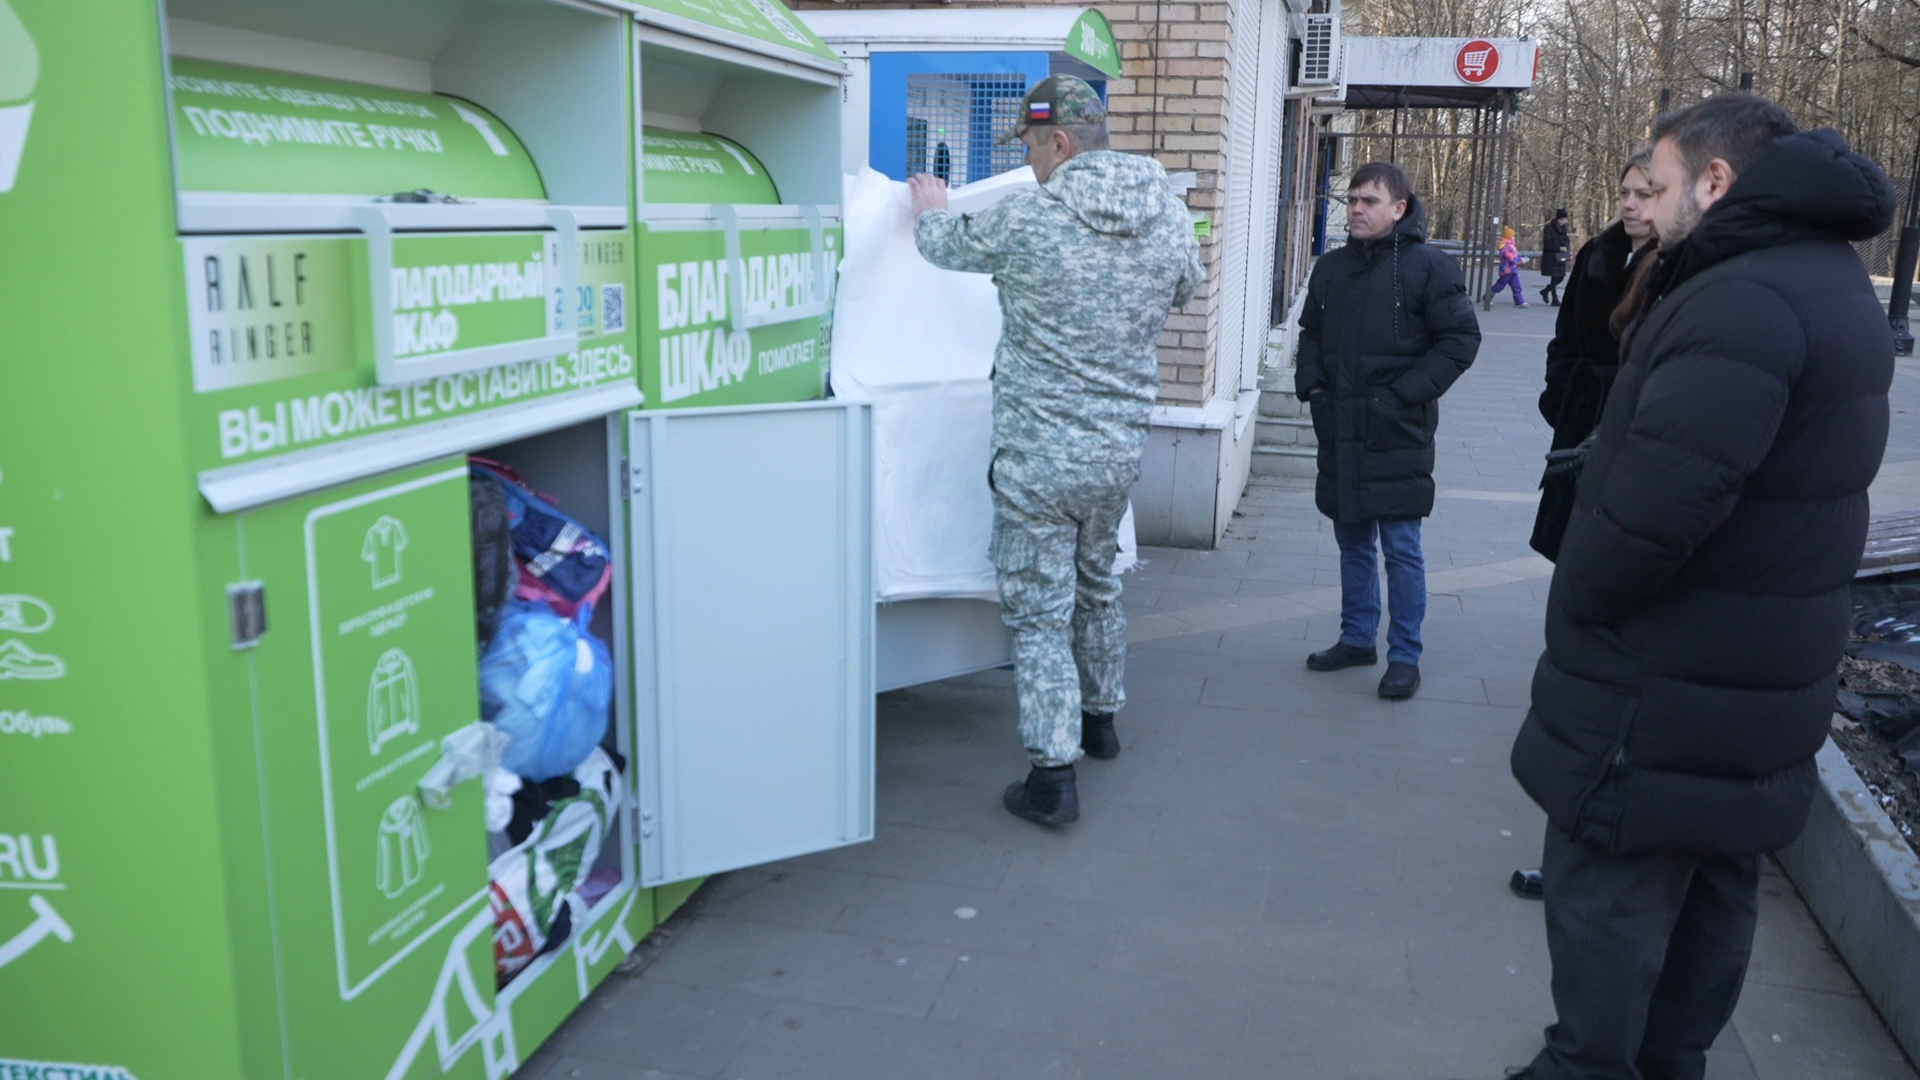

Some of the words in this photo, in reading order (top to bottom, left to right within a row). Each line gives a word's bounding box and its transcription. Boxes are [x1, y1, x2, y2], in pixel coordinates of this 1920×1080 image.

[181, 106, 374, 148] ПОДНИМИТЕ
[366, 123, 444, 153] РУЧКУ
[204, 253, 306, 312] RALF
[391, 251, 544, 309] ЛАГОДАРНЫЙ
[208, 321, 314, 364] RINGER
[659, 327, 752, 403] ШКАФ
[758, 338, 816, 376] ПОМОГАЕТ
[217, 402, 288, 459] ВЫ
[290, 378, 434, 445] МОЖЕТЕ
[434, 355, 567, 411] ОСТАВИТЬ
[567, 344, 632, 389] ЗДЕСЬ
[0, 710, 72, 738] Обувь
